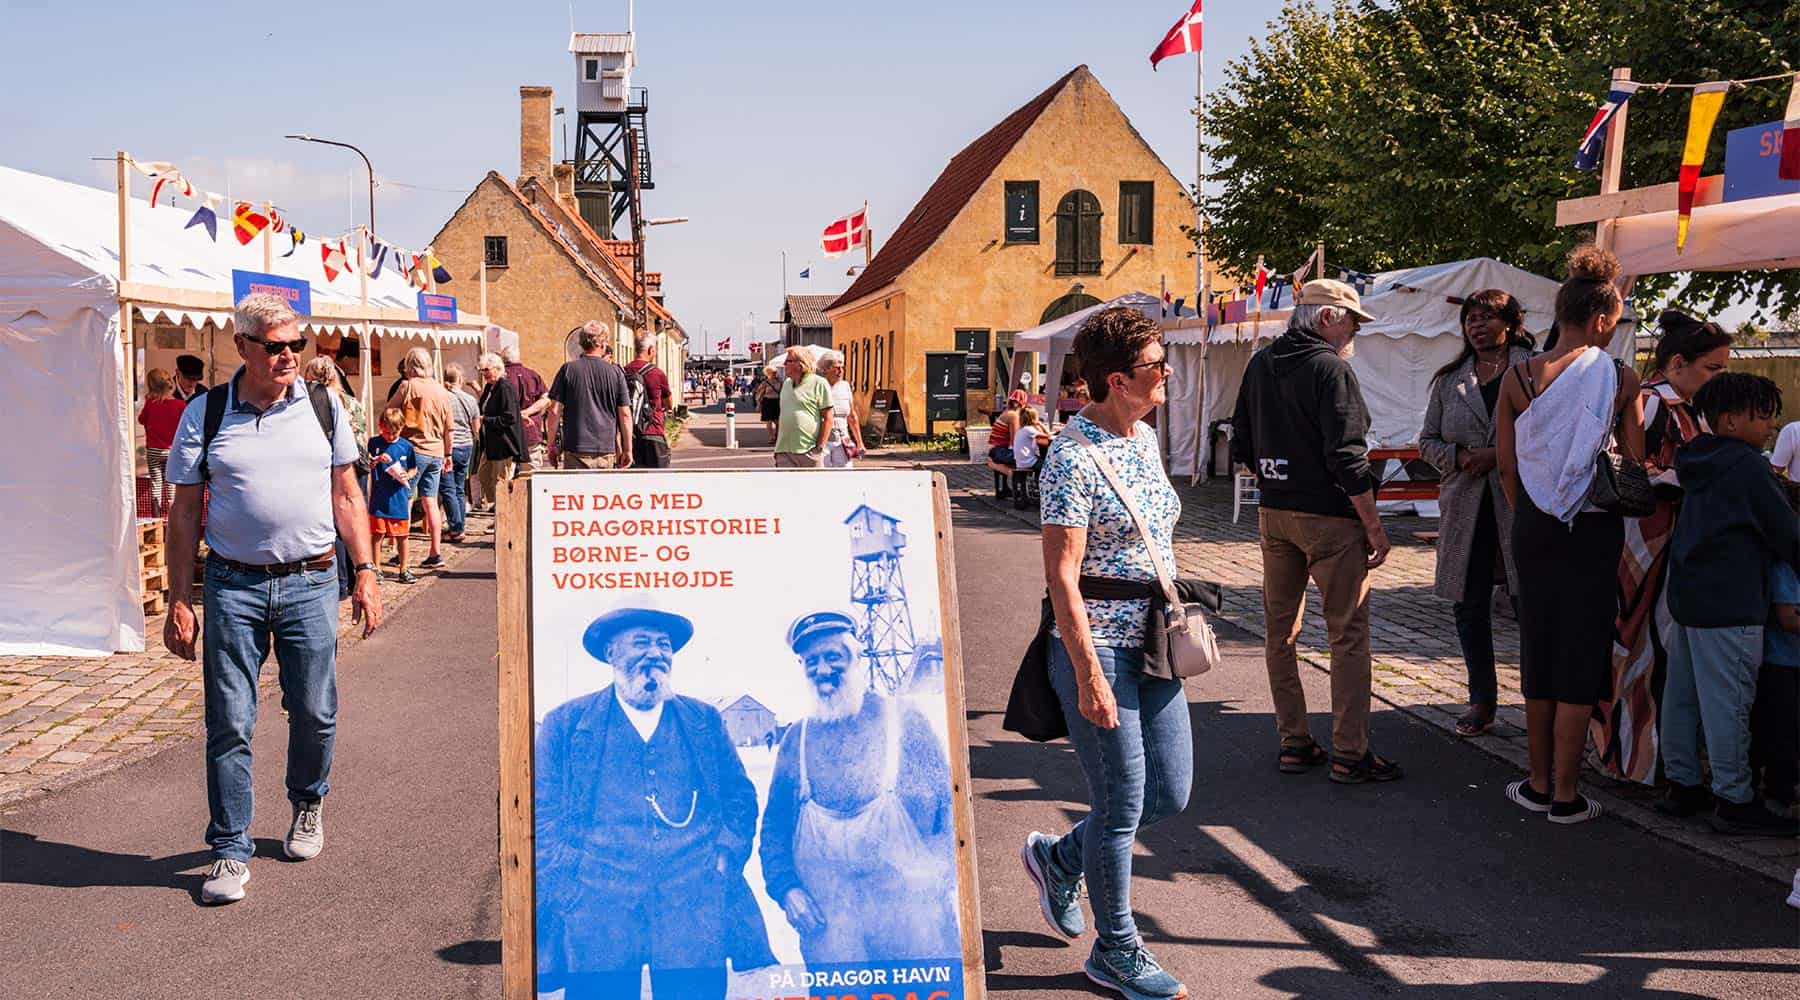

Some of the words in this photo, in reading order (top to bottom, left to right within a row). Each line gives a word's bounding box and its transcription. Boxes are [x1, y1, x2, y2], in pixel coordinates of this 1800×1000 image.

[552, 494, 584, 511] EN
[592, 493, 643, 511] DAG
[650, 493, 703, 510] MED
[552, 518, 767, 537] DRAGØRHISTORIE
[773, 518, 781, 535] I
[552, 546, 648, 564] BØRNE-
[656, 545, 690, 562] OG
[552, 570, 733, 590] VOKSENHØJDE
[768, 968, 795, 989] PÅ
[800, 968, 887, 988] DRAGØR
[893, 966, 951, 984] HAVN
